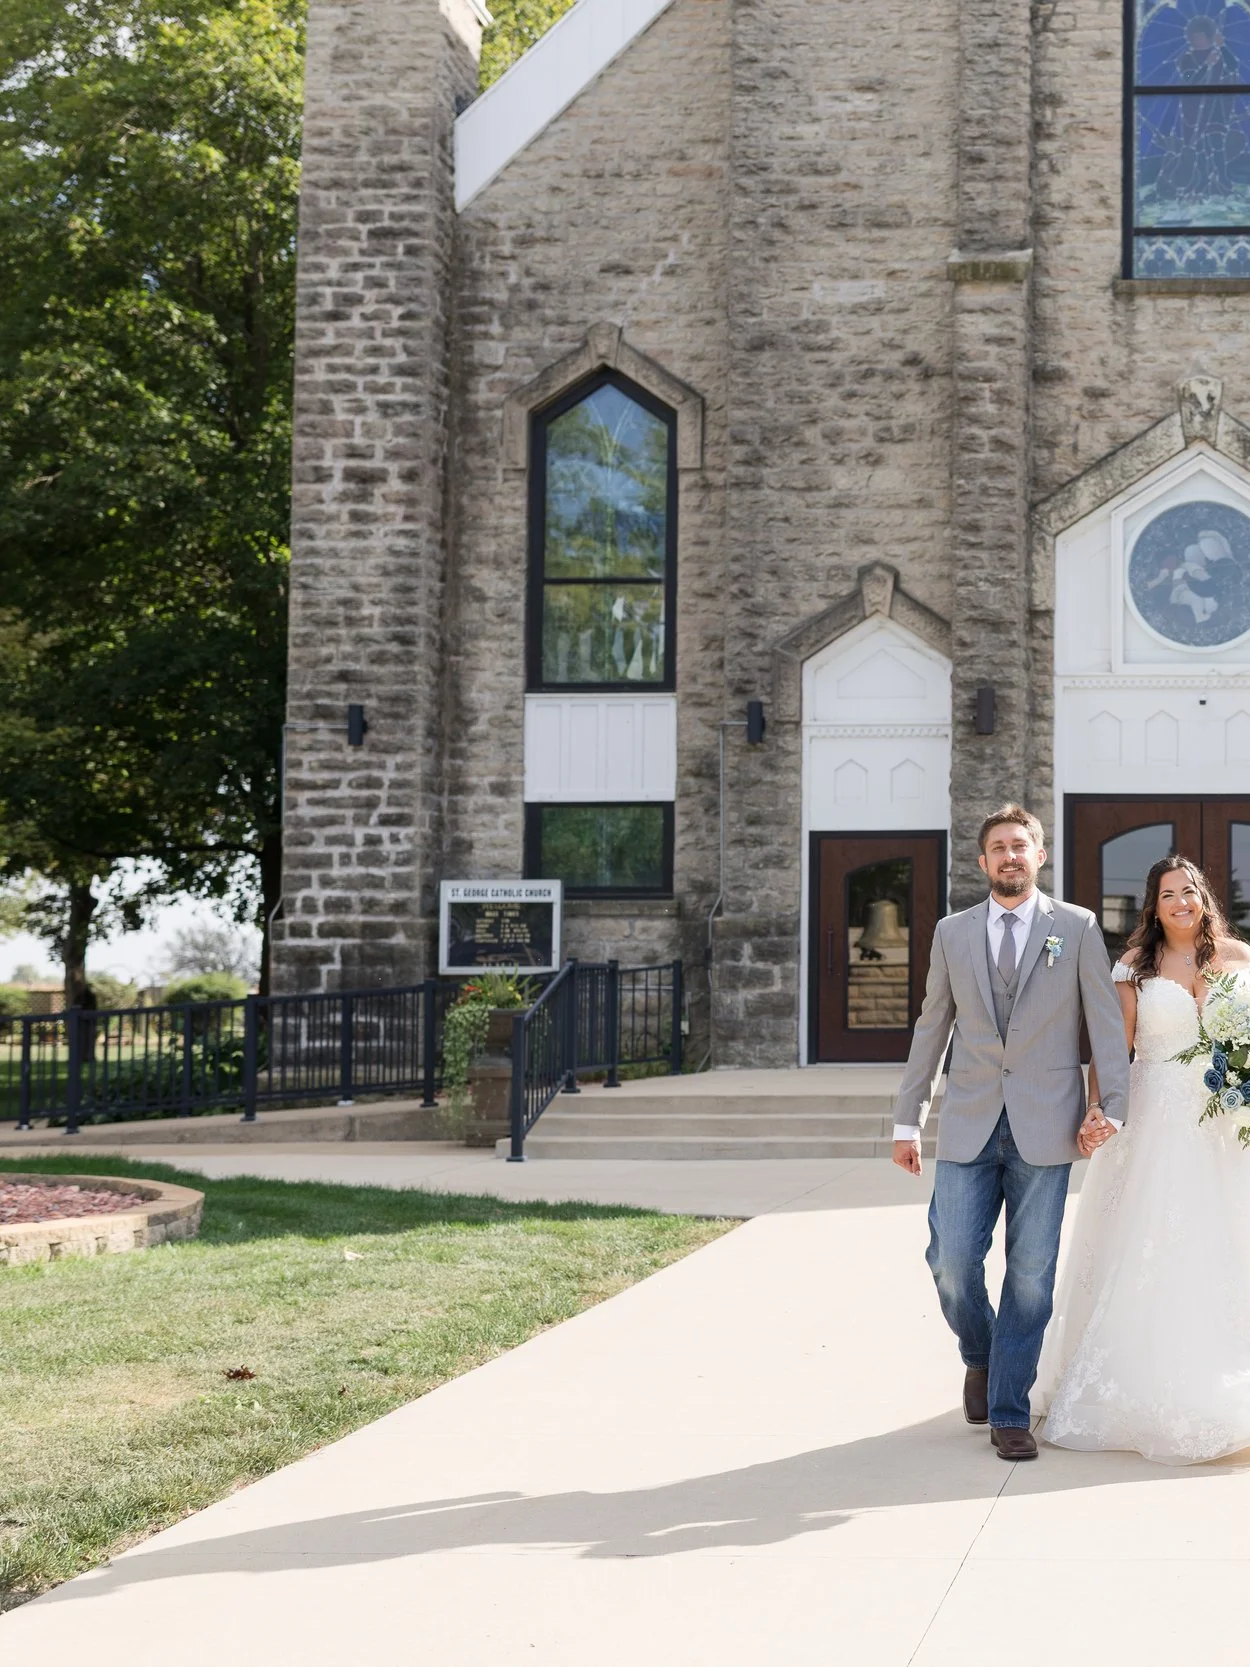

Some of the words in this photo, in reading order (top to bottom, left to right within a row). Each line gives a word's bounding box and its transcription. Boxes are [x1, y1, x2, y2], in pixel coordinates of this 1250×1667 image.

[451, 888, 461, 898] ST.
[463, 888, 489, 897] GEORGE
[491, 888, 522, 897] CATHOLIC
[525, 888, 552, 897] CHURCH
